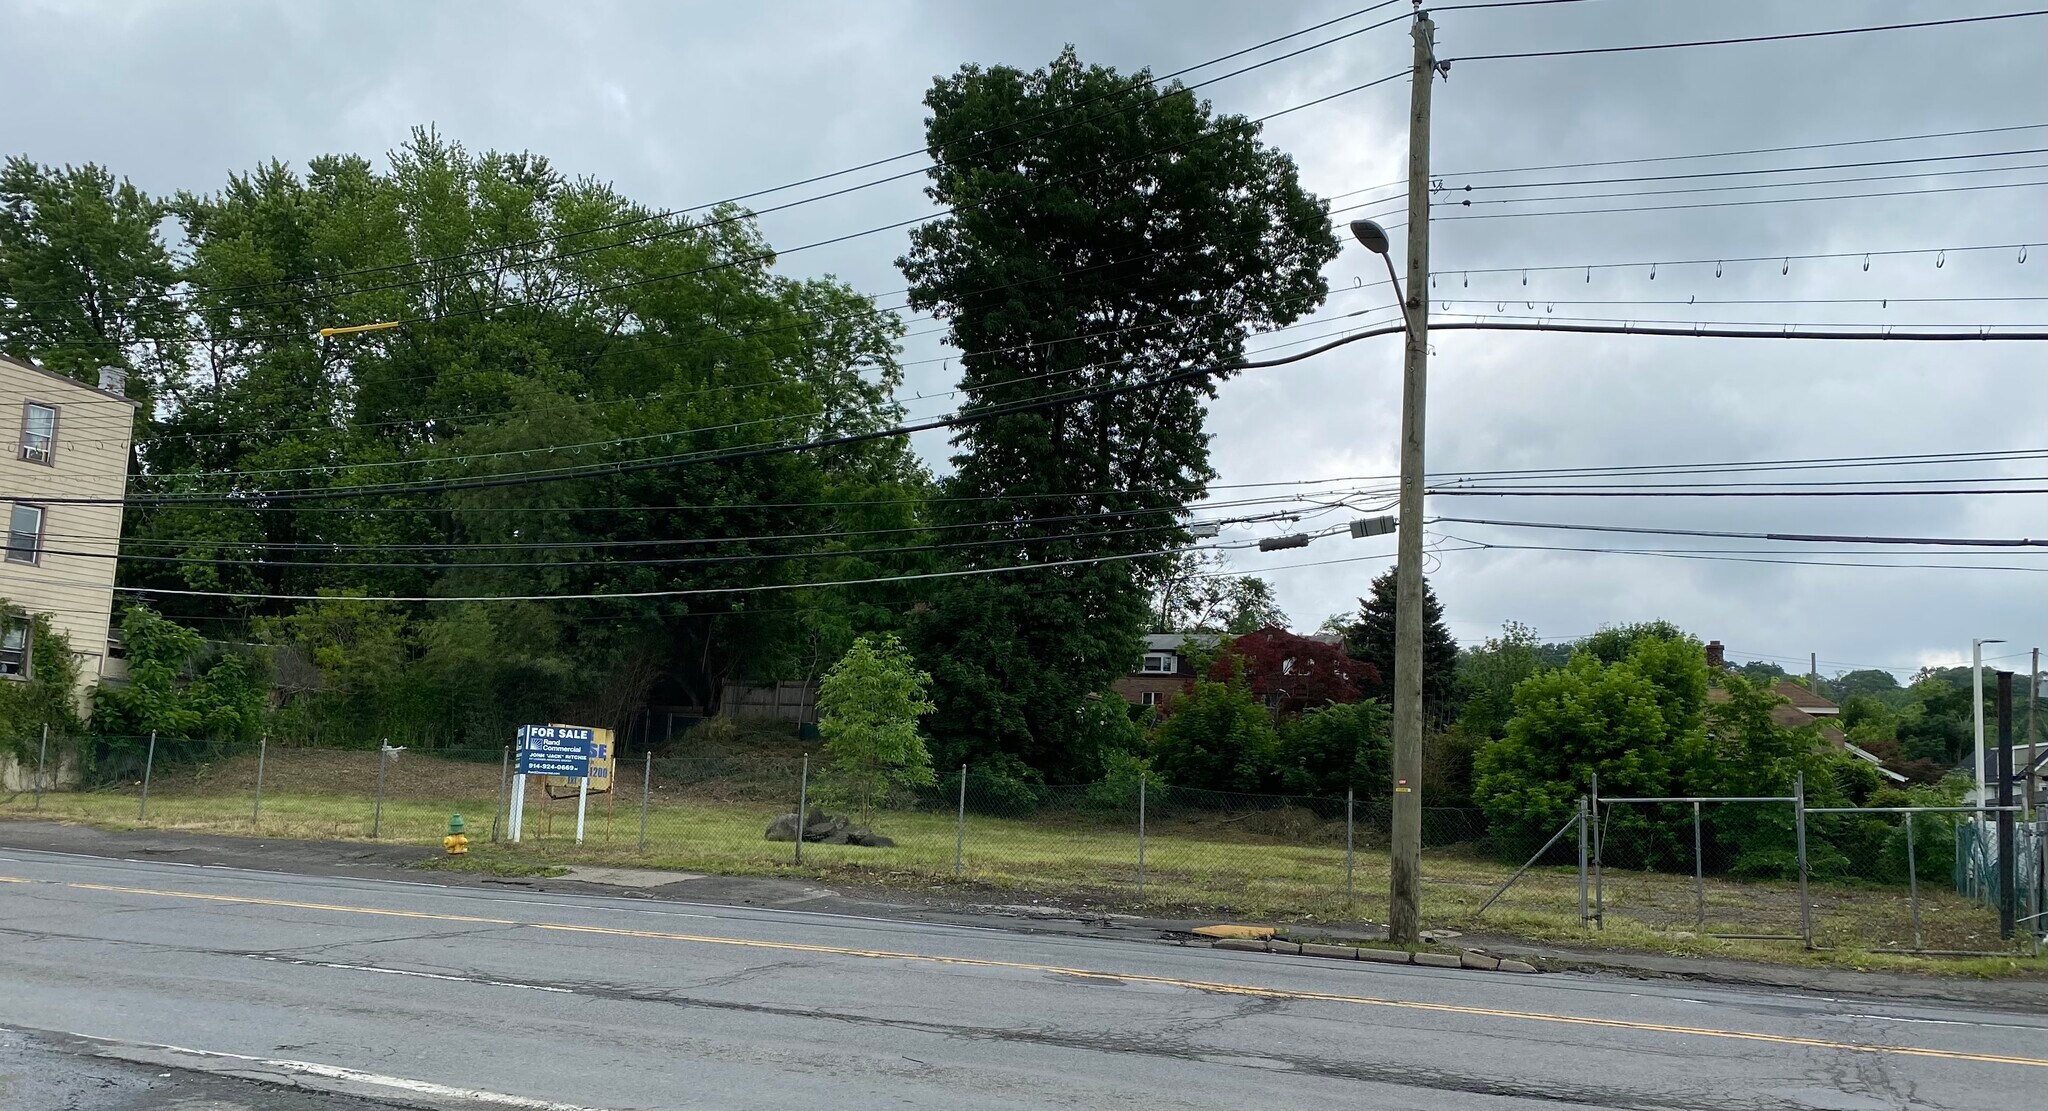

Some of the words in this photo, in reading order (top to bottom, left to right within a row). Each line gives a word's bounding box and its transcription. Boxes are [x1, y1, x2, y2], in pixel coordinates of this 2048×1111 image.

[531, 727, 554, 737] FOR
[558, 729, 588, 739] SALE
[543, 745, 581, 753] Commercial
